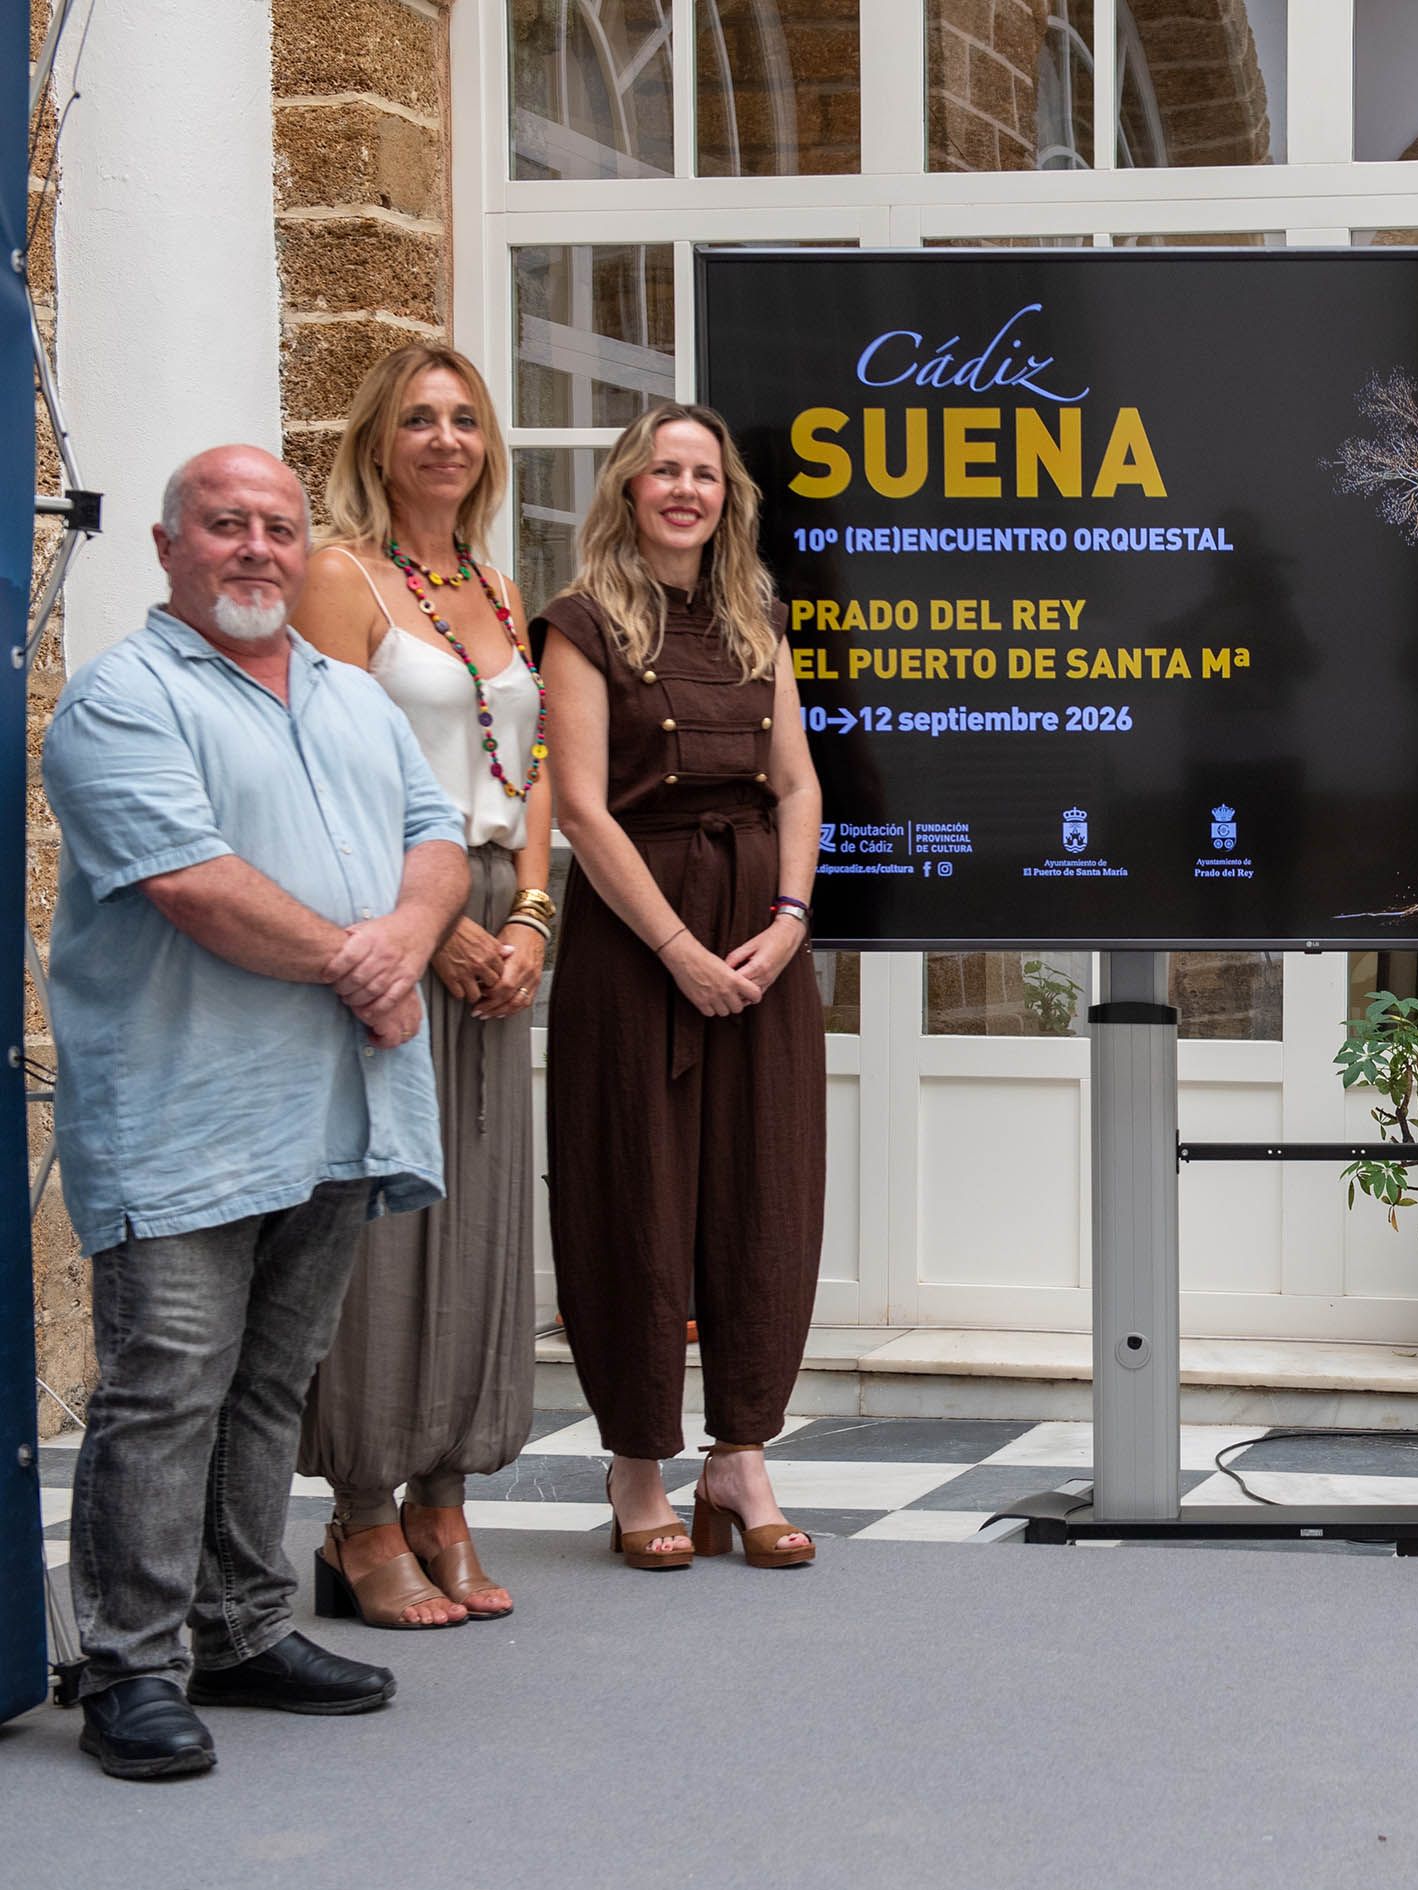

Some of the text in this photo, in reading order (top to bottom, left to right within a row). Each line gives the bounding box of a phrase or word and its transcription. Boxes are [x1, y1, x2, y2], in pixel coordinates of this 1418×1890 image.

[857, 304, 1090, 402] Cádiz
[788, 407, 1168, 498] SUENA
[845, 526, 1067, 554] (RE)ENCUENTRO
[1073, 527, 1234, 552] ORQUESTAL
[791, 599, 1086, 630] PRADO DEL REY
[792, 648, 839, 679] EL
[849, 648, 997, 679] PUERTO
[1008, 648, 1056, 679] DE
[1065, 648, 1191, 679] SANTA
[898, 706, 1059, 736] septiembre
[1065, 706, 1133, 732] 2026
[840, 823, 904, 838] Diputación
[916, 822, 969, 832] FUNDACIÓN
[916, 834, 971, 843] PROVINCIAL
[840, 839, 893, 853] de Cádiz
[916, 844, 973, 853] DE CULTURA
[1044, 859, 1107, 868] Ayuntamiento de
[1196, 858, 1252, 867] Ayuntamiento de
[1023, 867, 1128, 876] El Puerto de Santa María
[1194, 868, 1254, 878] Prado del Rey
